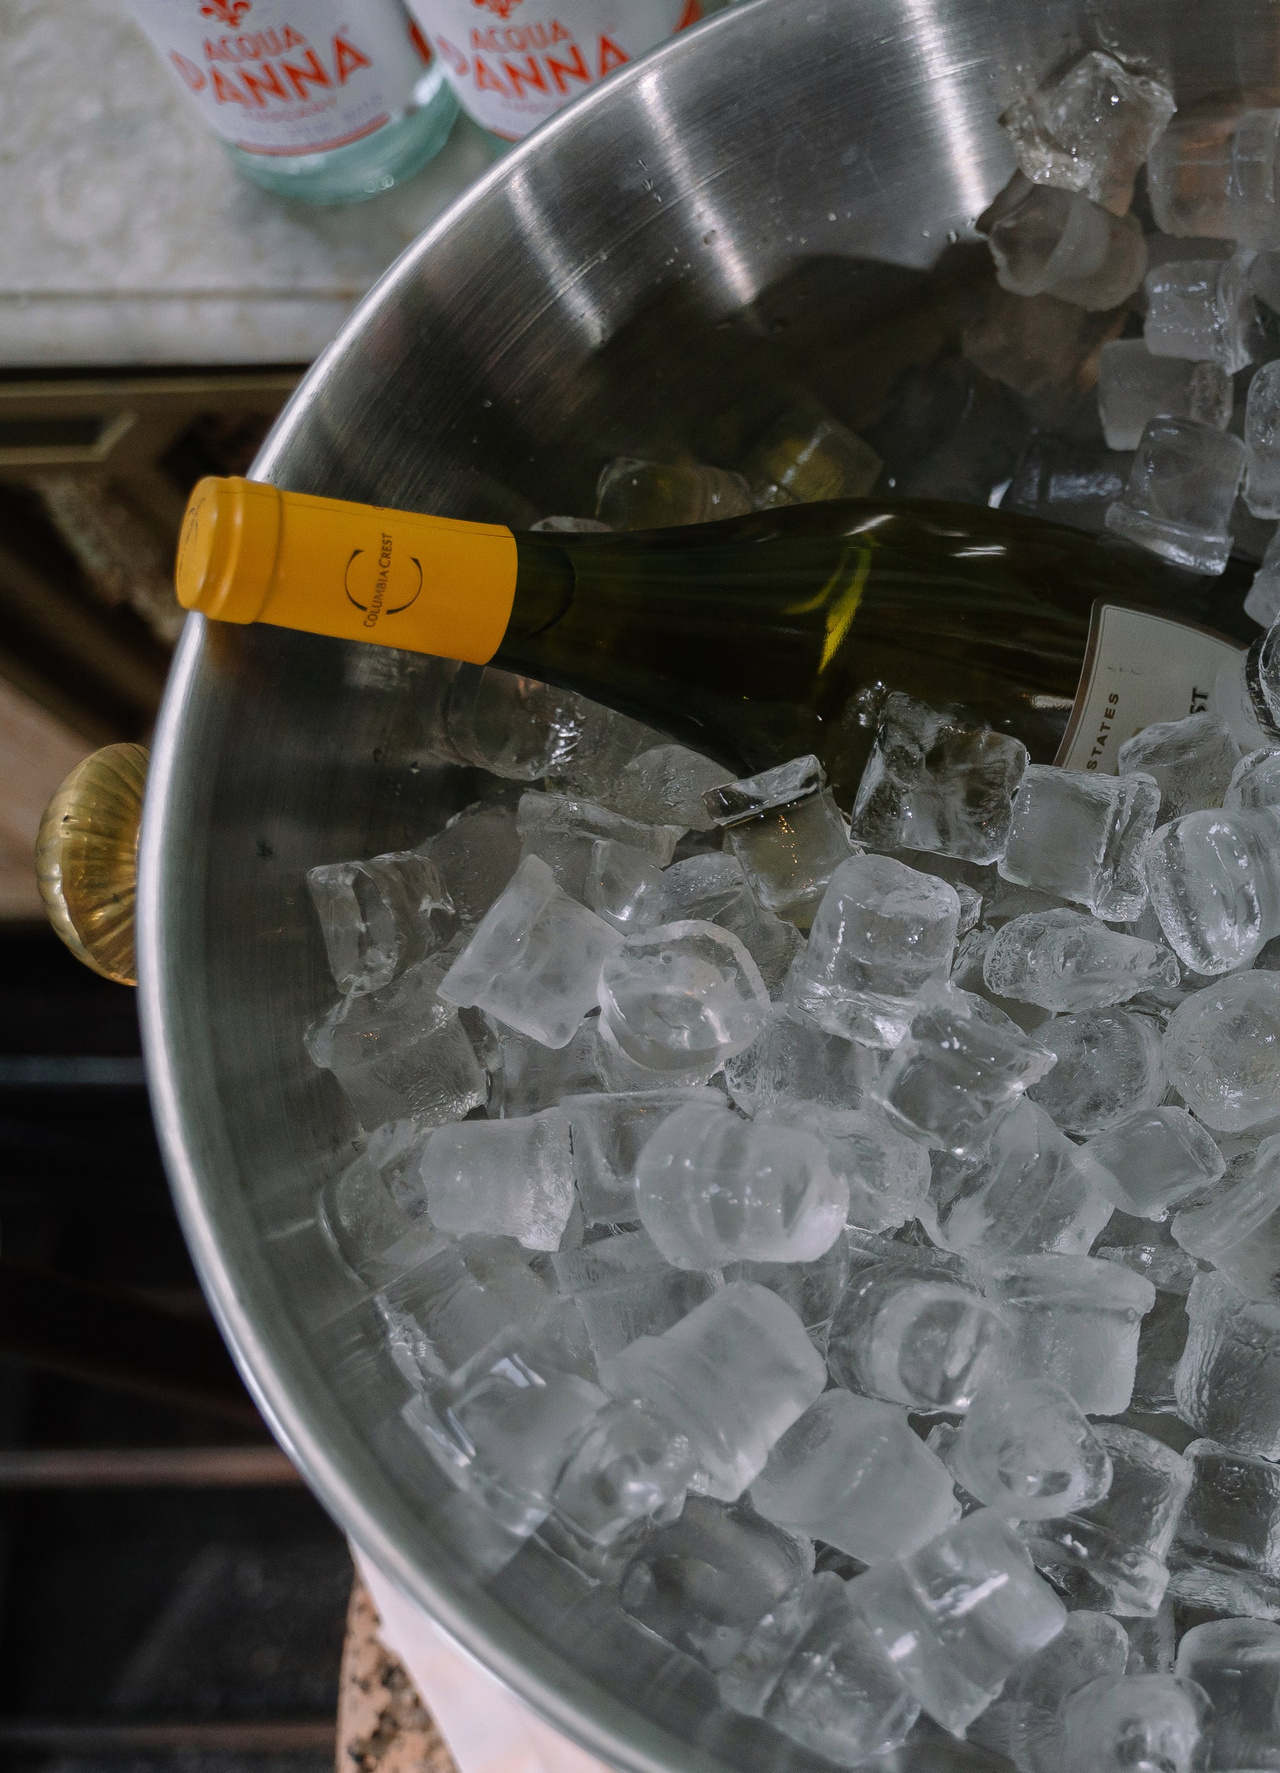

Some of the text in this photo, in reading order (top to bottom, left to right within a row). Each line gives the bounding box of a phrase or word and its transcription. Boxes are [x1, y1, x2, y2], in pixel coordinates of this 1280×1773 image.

[203, 23, 307, 64] ACQUA
[469, 19, 573, 53] ACQUA
[363, 532, 393, 628] COLUMBIA CREST
[1086, 692, 1120, 771] STATES
